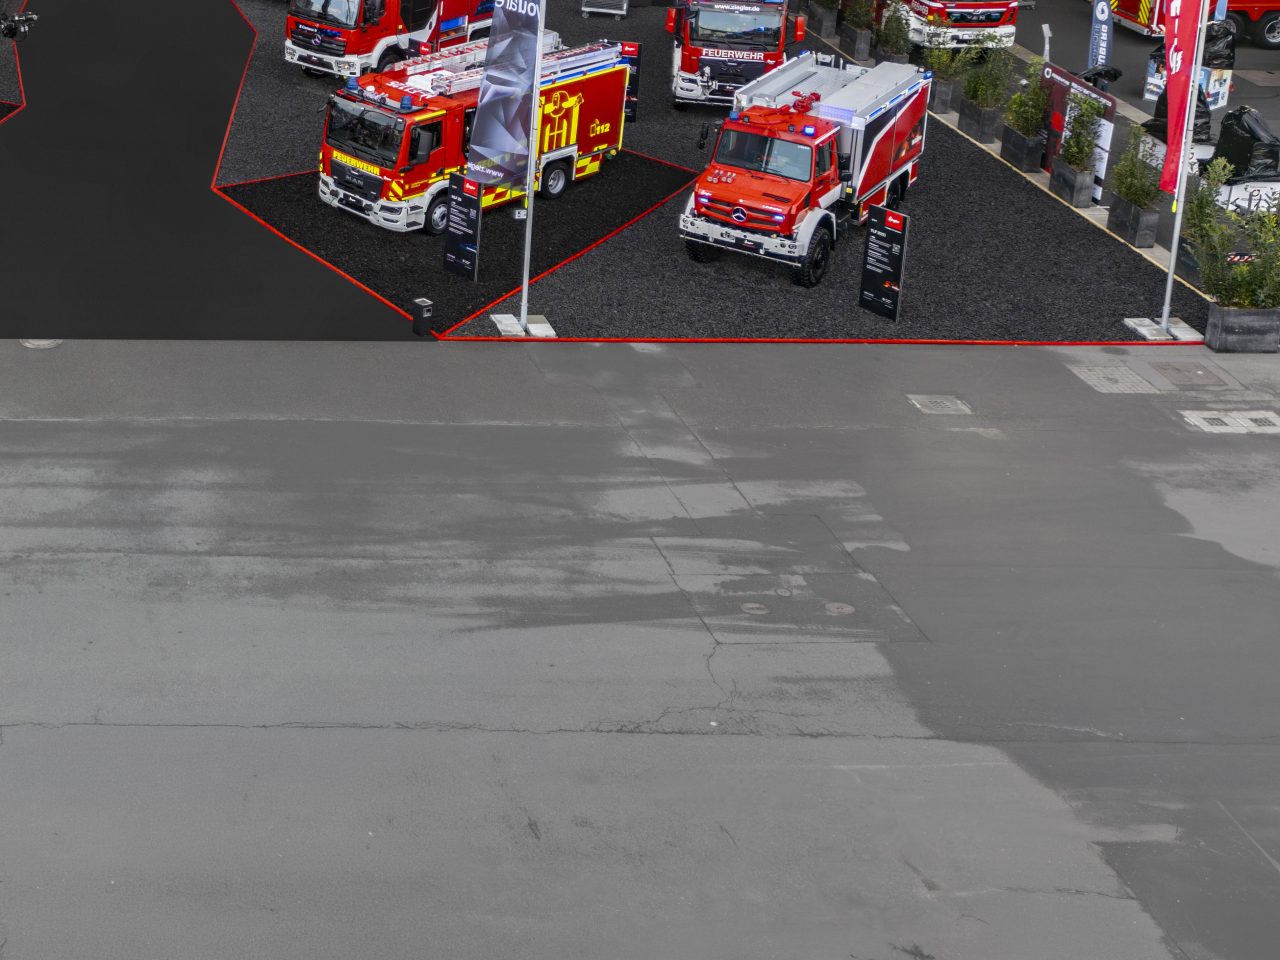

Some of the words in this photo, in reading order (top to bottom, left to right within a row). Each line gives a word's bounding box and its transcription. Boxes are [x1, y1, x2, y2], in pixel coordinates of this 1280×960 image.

[702, 48, 765, 60] FEUERWEHR
[595, 123, 611, 135] 112
[332, 150, 380, 176] FEUERWEHR
